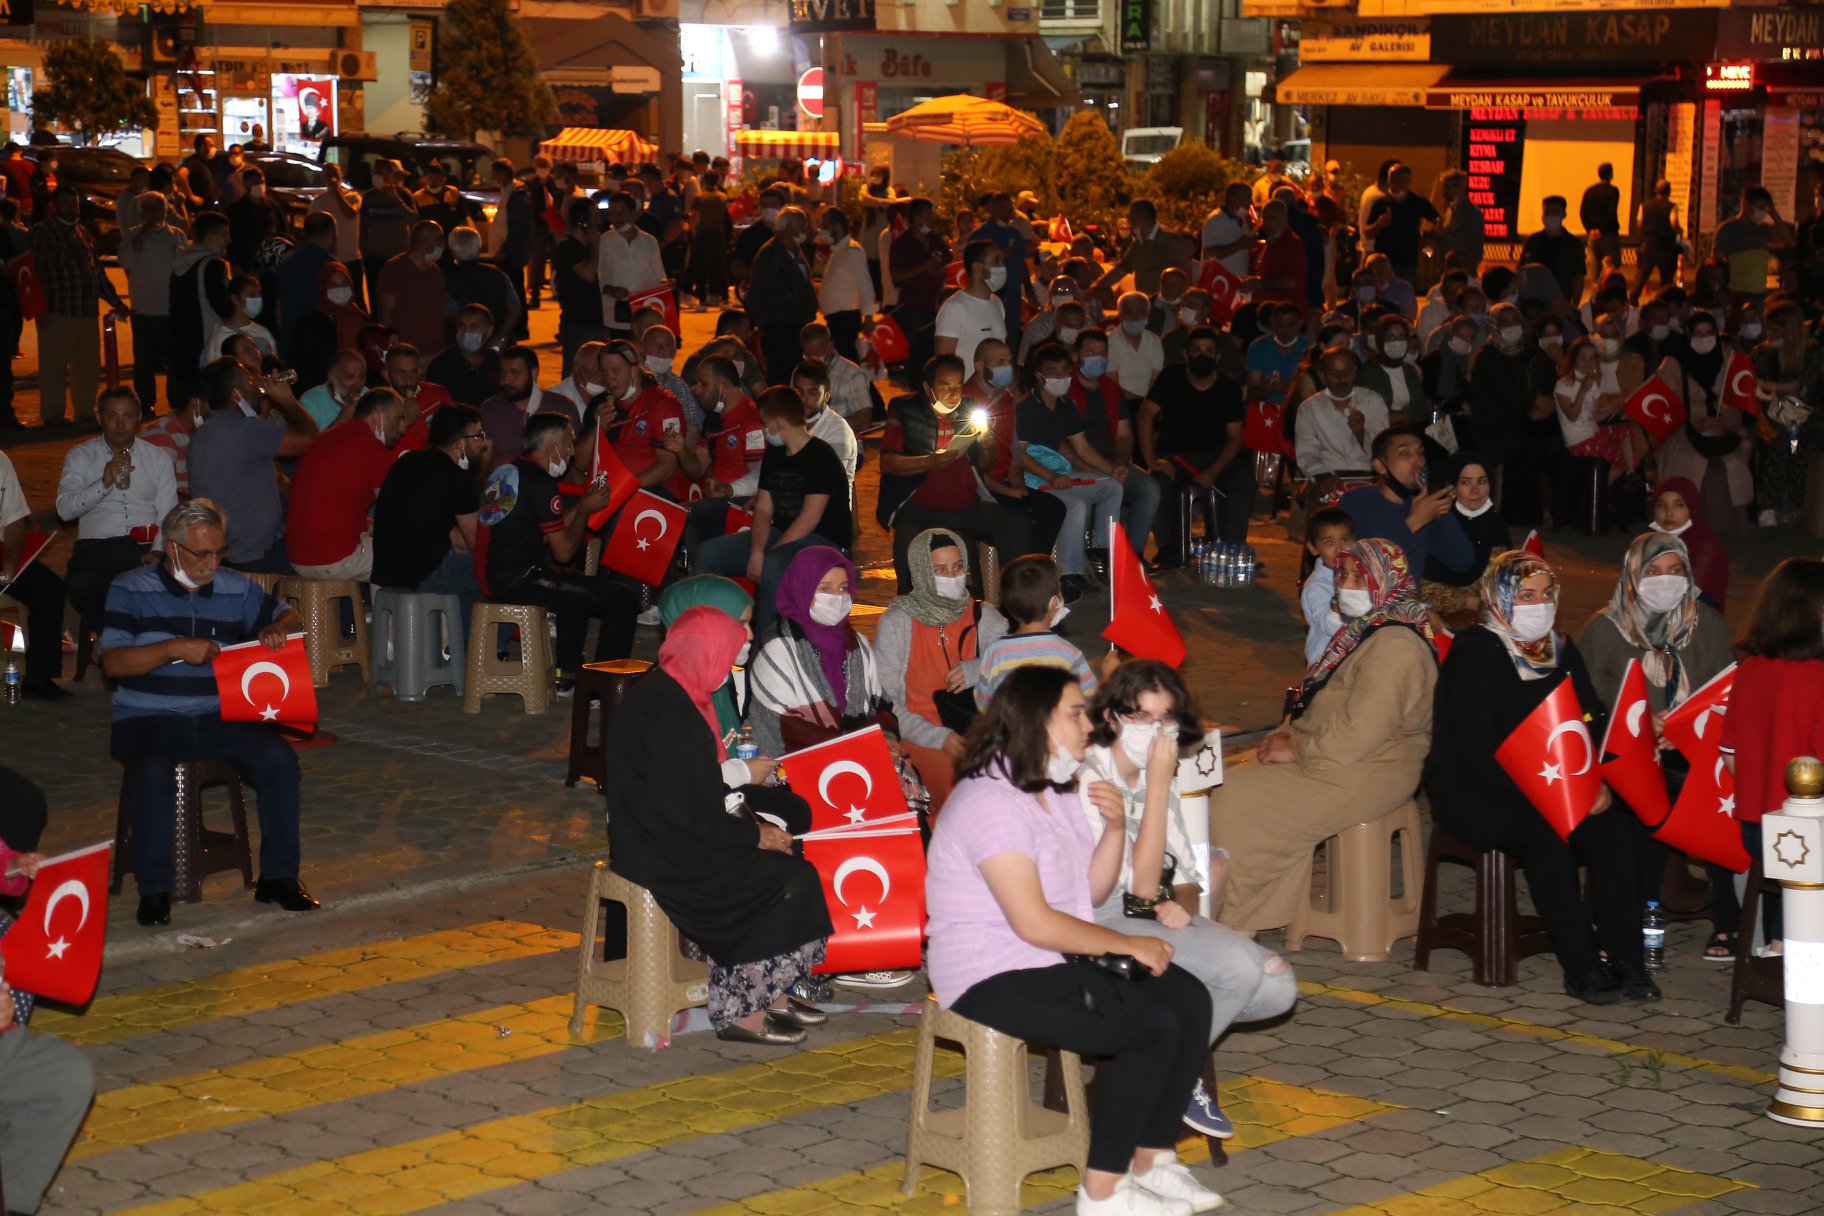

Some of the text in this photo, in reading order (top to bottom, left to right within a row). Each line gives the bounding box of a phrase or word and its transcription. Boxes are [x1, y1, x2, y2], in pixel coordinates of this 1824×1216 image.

[1586, 13, 1671, 45] KASAP
[1750, 13, 1819, 44] MEYDAN
[881, 48, 932, 78] Büfe
[1450, 94, 1492, 107] MEYDAN
[1495, 94, 1531, 107] KASAP
